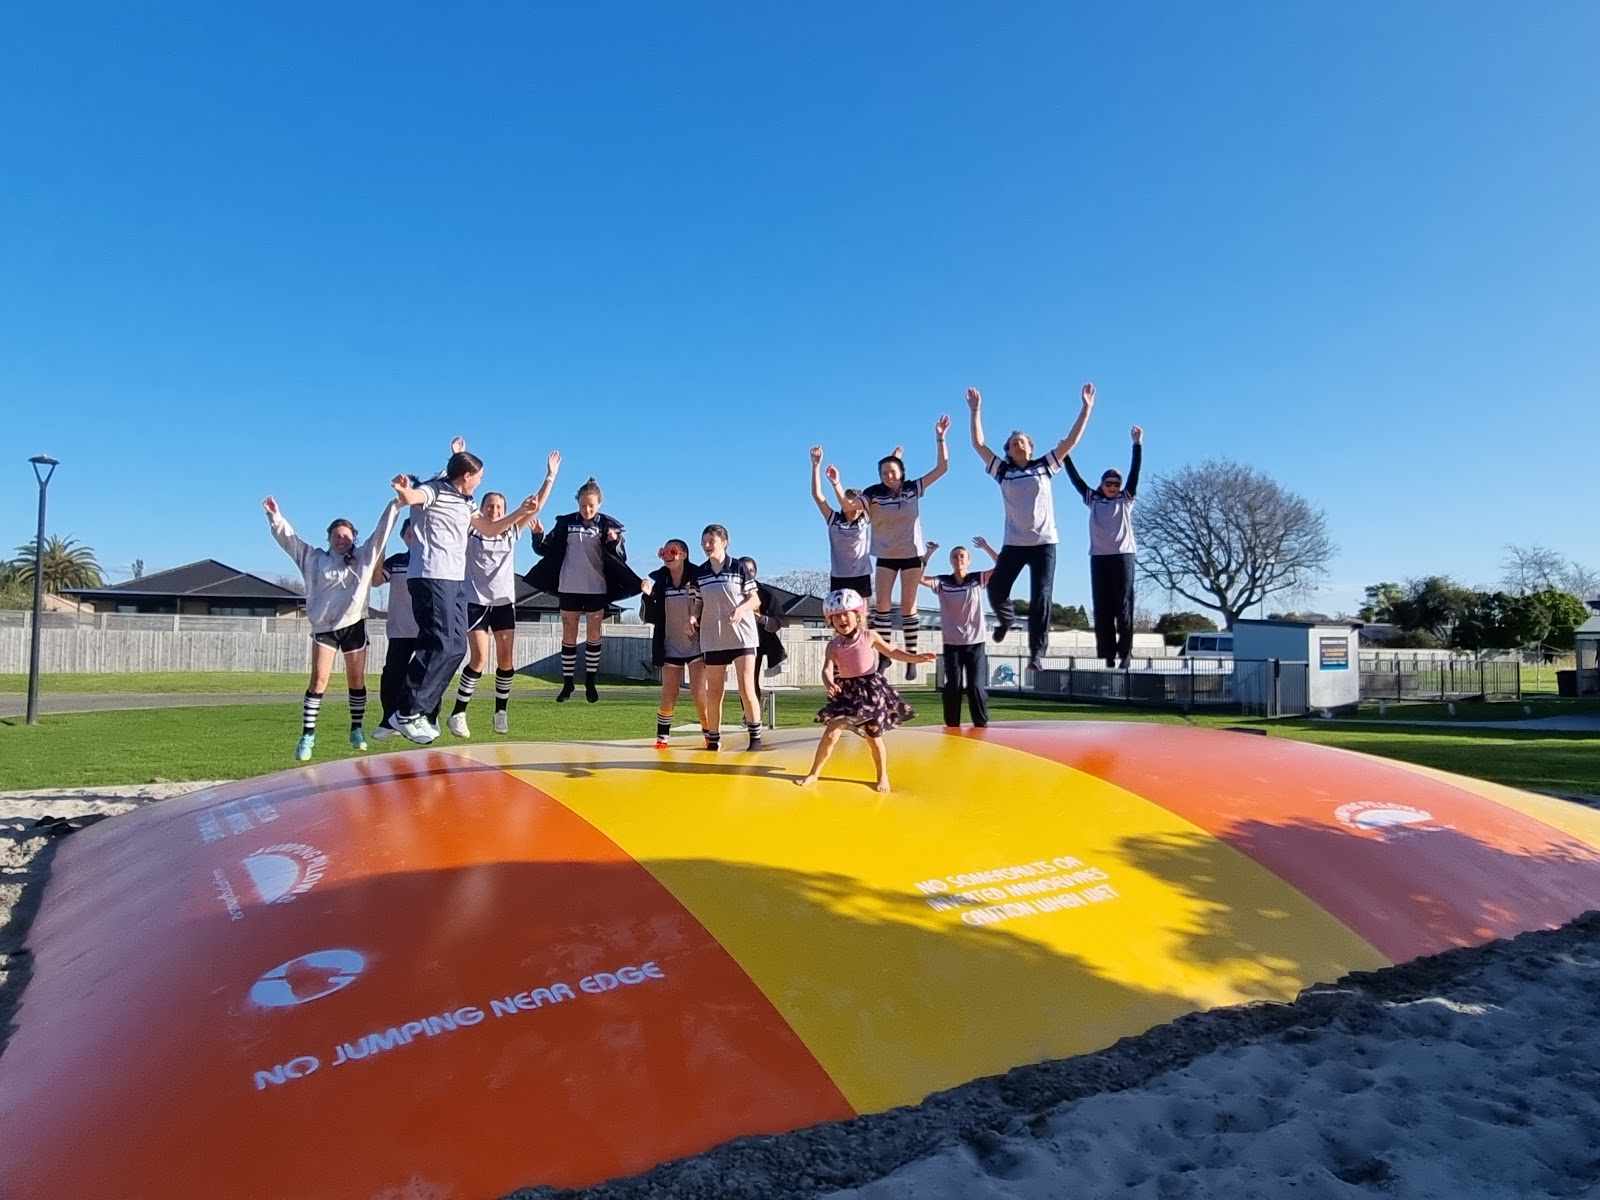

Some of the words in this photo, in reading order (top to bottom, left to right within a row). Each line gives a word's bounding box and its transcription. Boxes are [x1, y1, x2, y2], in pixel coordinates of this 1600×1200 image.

[914, 879, 948, 894] NO
[960, 902, 1038, 927] CAUTION
[1033, 892, 1087, 913] WHEN
[1082, 884, 1120, 903] WET
[253, 1055, 320, 1091] NO
[331, 1006, 485, 1067] JUMPING
[489, 982, 577, 1018] NEAR
[578, 961, 666, 995] EDGE
